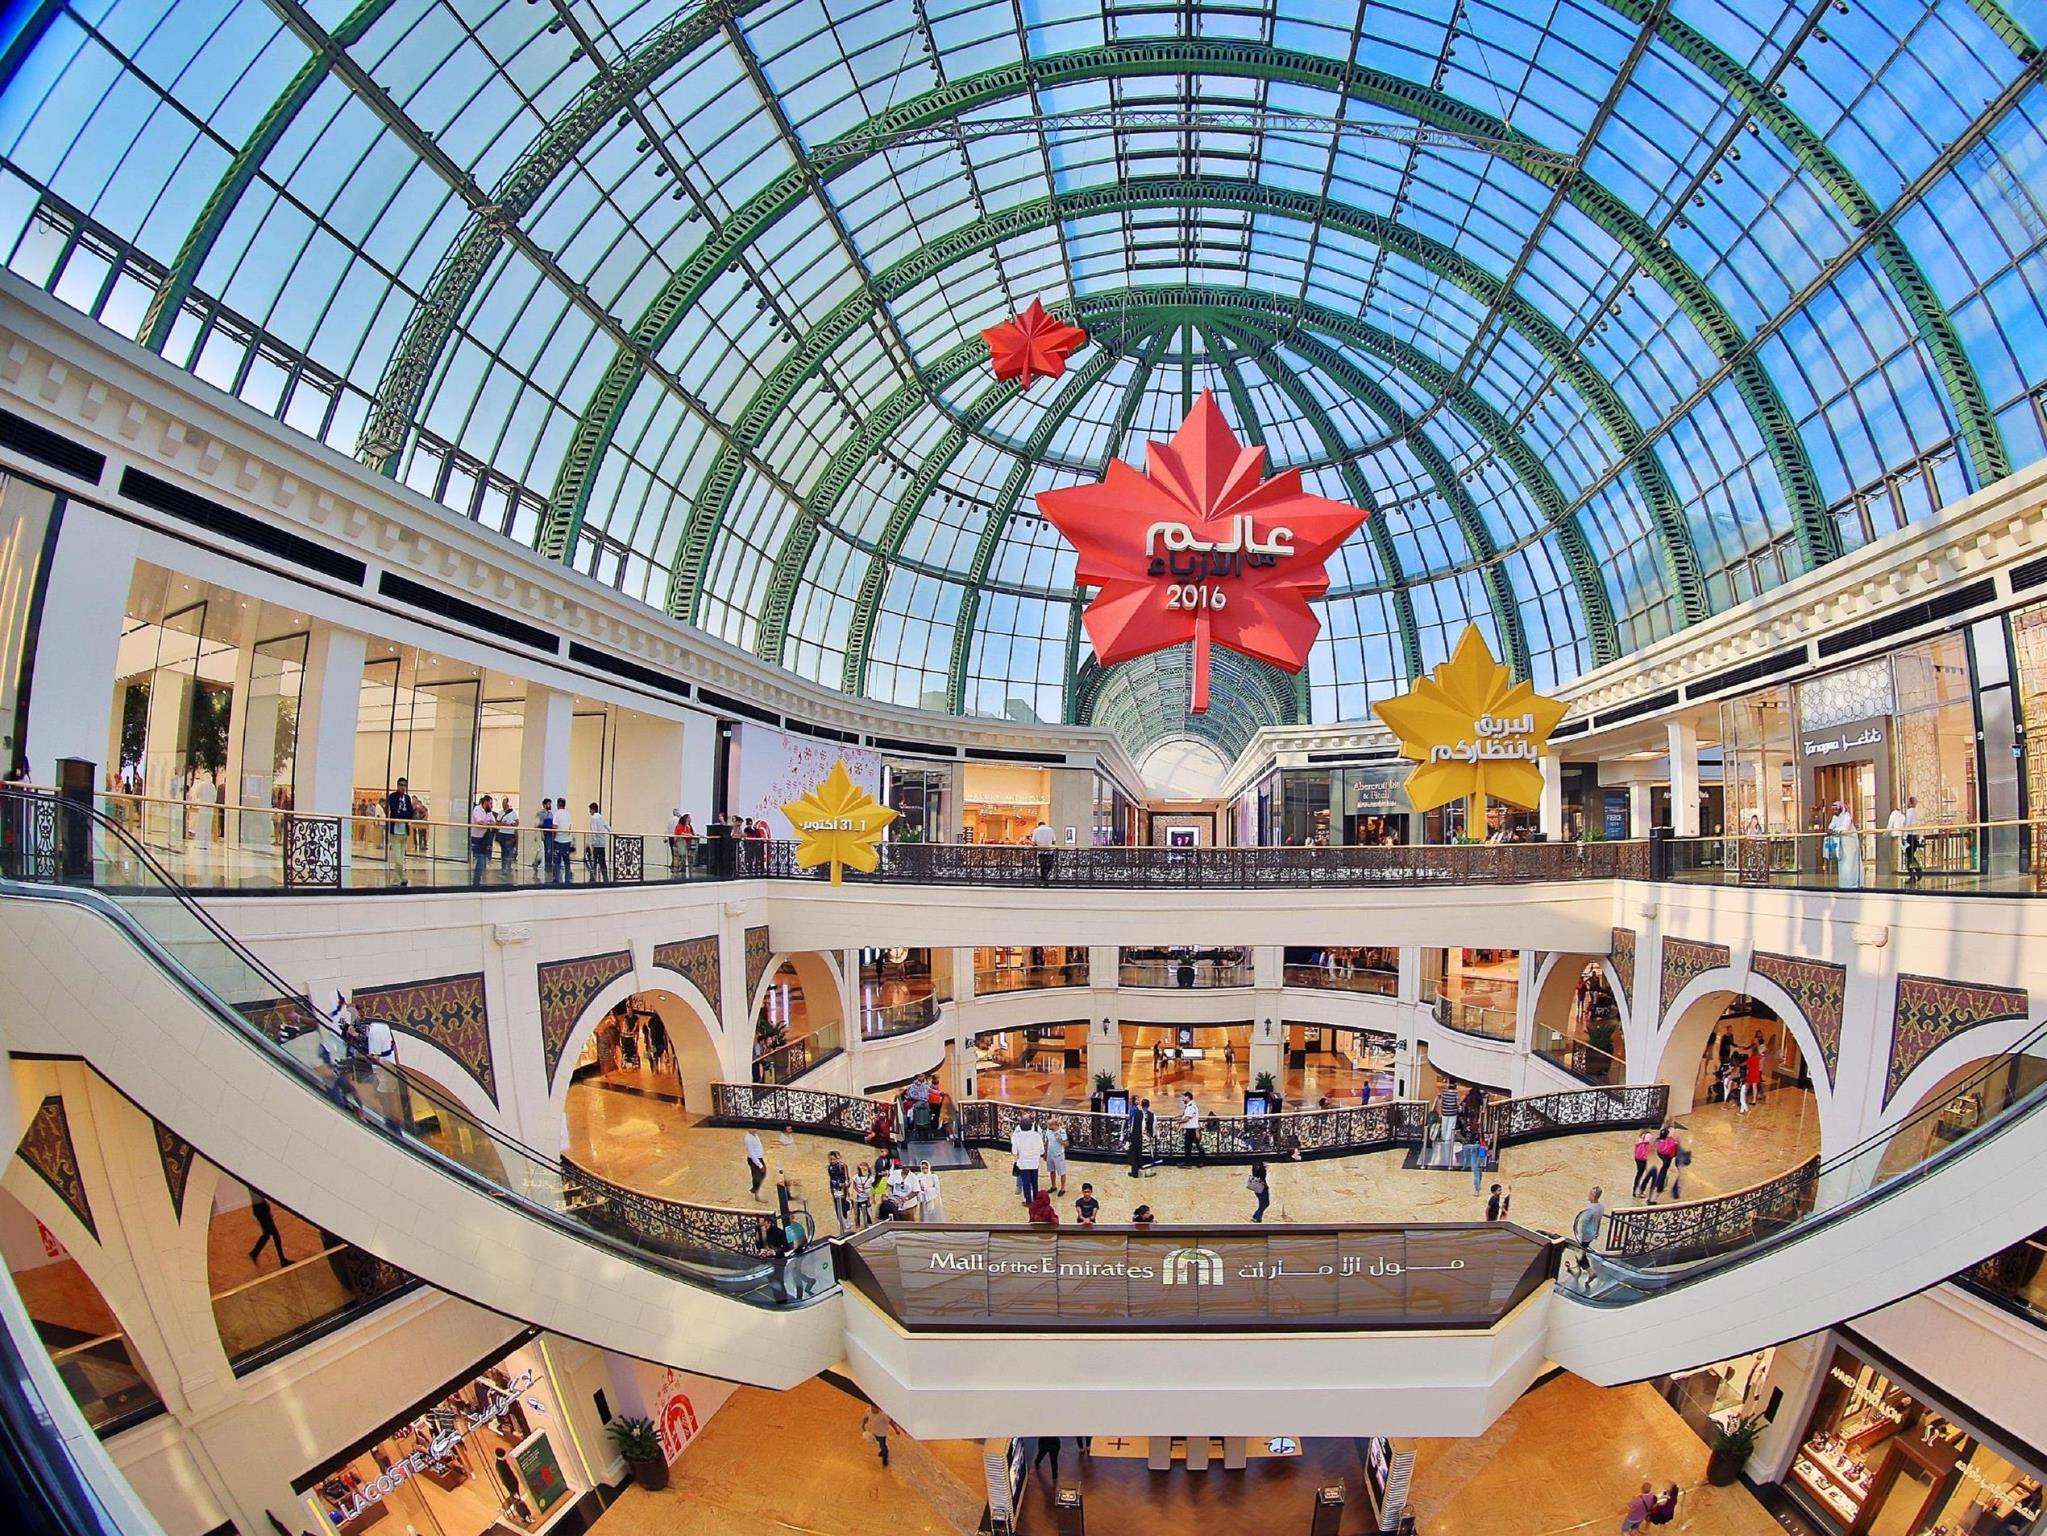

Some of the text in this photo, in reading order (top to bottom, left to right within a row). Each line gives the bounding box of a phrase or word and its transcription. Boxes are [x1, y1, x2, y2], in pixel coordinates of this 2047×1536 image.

[1145, 514, 1295, 557] عالم
[1166, 584, 1227, 612] 2016
[1474, 713, 1535, 739] البريق
[1430, 739, 1539, 764] بانتظاركم
[929, 1252, 1154, 1279] Mall of the Emirates
[340, 1451, 429, 1521] LACOSTE
